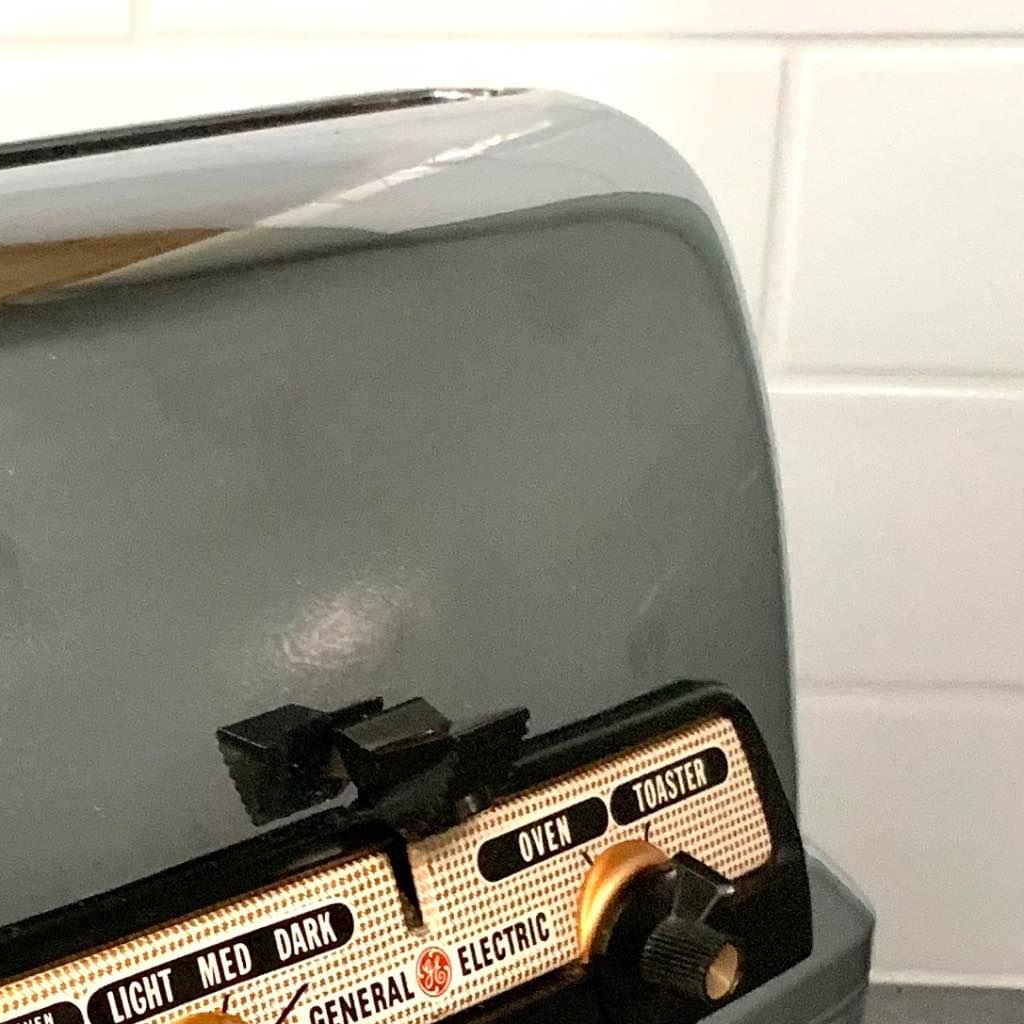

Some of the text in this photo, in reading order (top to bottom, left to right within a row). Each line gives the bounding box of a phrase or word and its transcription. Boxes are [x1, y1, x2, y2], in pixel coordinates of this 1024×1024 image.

[631, 757, 708, 813] TOASTER
[518, 816, 572, 863] OVEN
[107, 911, 338, 1024] LIGHT MED DARK
[458, 911, 551, 977] ELECTRIC
